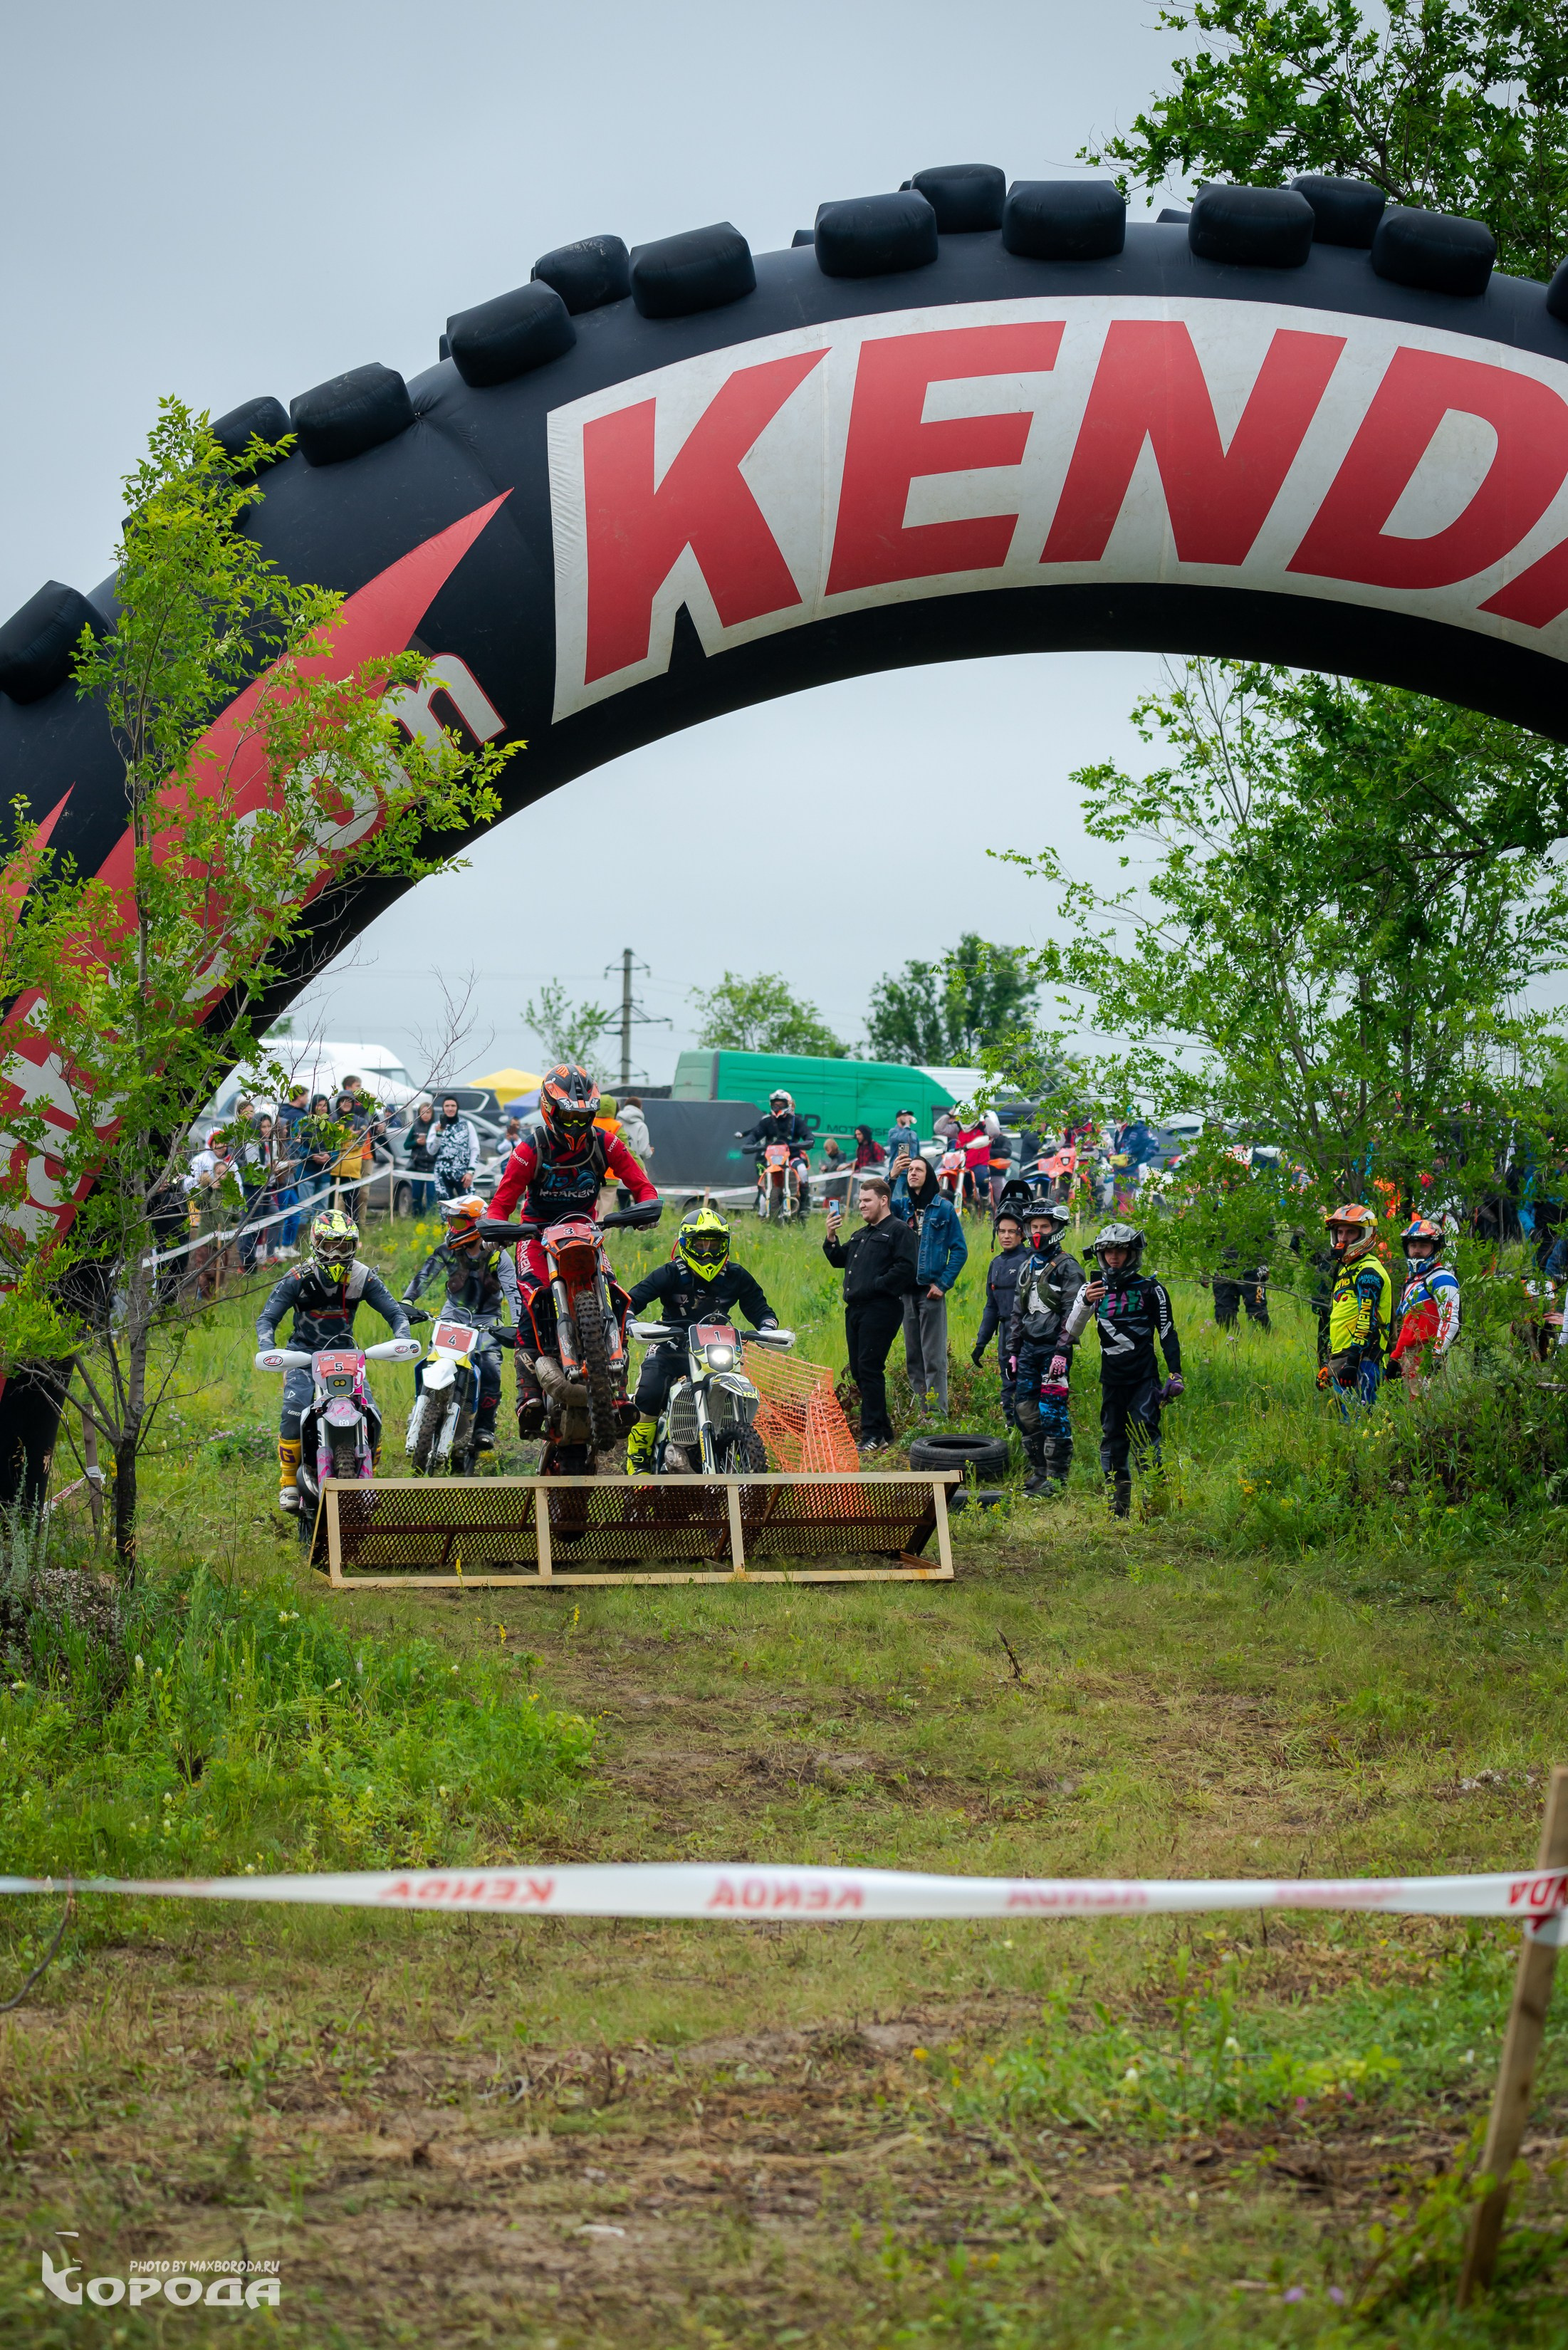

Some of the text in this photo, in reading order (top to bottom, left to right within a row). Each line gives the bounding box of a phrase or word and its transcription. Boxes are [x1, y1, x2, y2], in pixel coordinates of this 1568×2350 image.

[582, 320, 1568, 686] KEND
[563, 1227, 574, 1236] 3
[447, 1335, 457, 1346] 4
[714, 1330, 721, 1342] 1
[334, 1362, 344, 1372] 5
